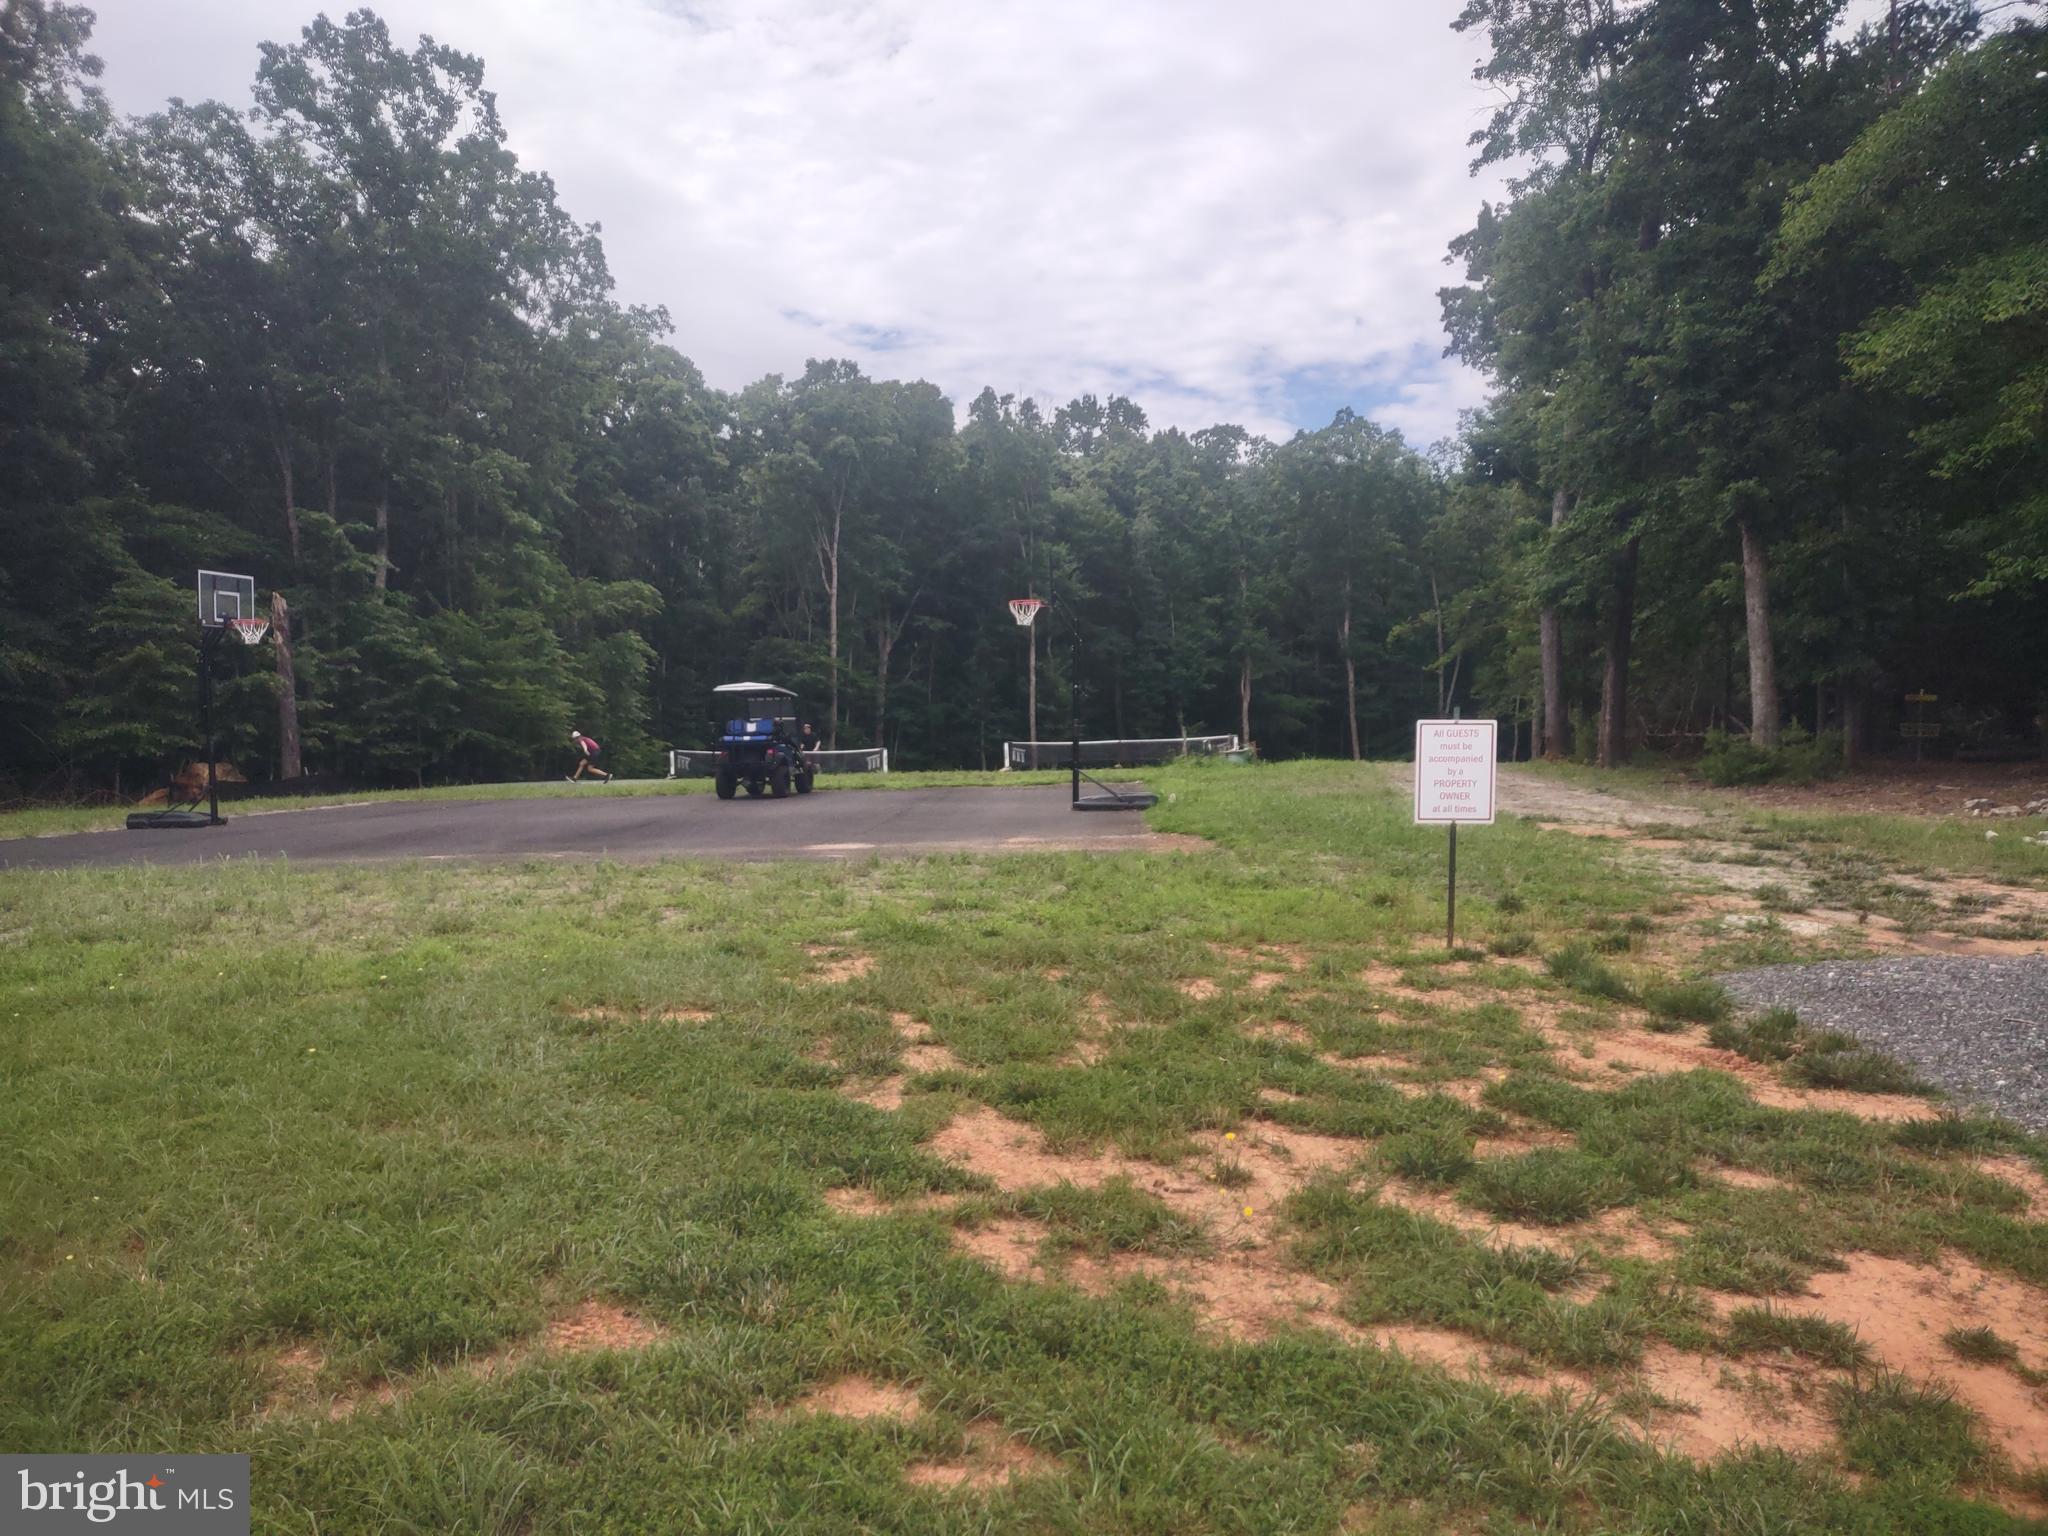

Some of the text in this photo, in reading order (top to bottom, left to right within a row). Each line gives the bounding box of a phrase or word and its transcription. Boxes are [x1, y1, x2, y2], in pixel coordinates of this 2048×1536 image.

[1433, 729, 1480, 738] All GUESTS
[1462, 742, 1473, 750] be
[1428, 755, 1484, 764] accompanied
[1447, 768, 1457, 776] by
[1433, 780, 1477, 788] PROPERTY
[1439, 792, 1470, 800] OWNER
[1432, 805, 1477, 813] at all times
